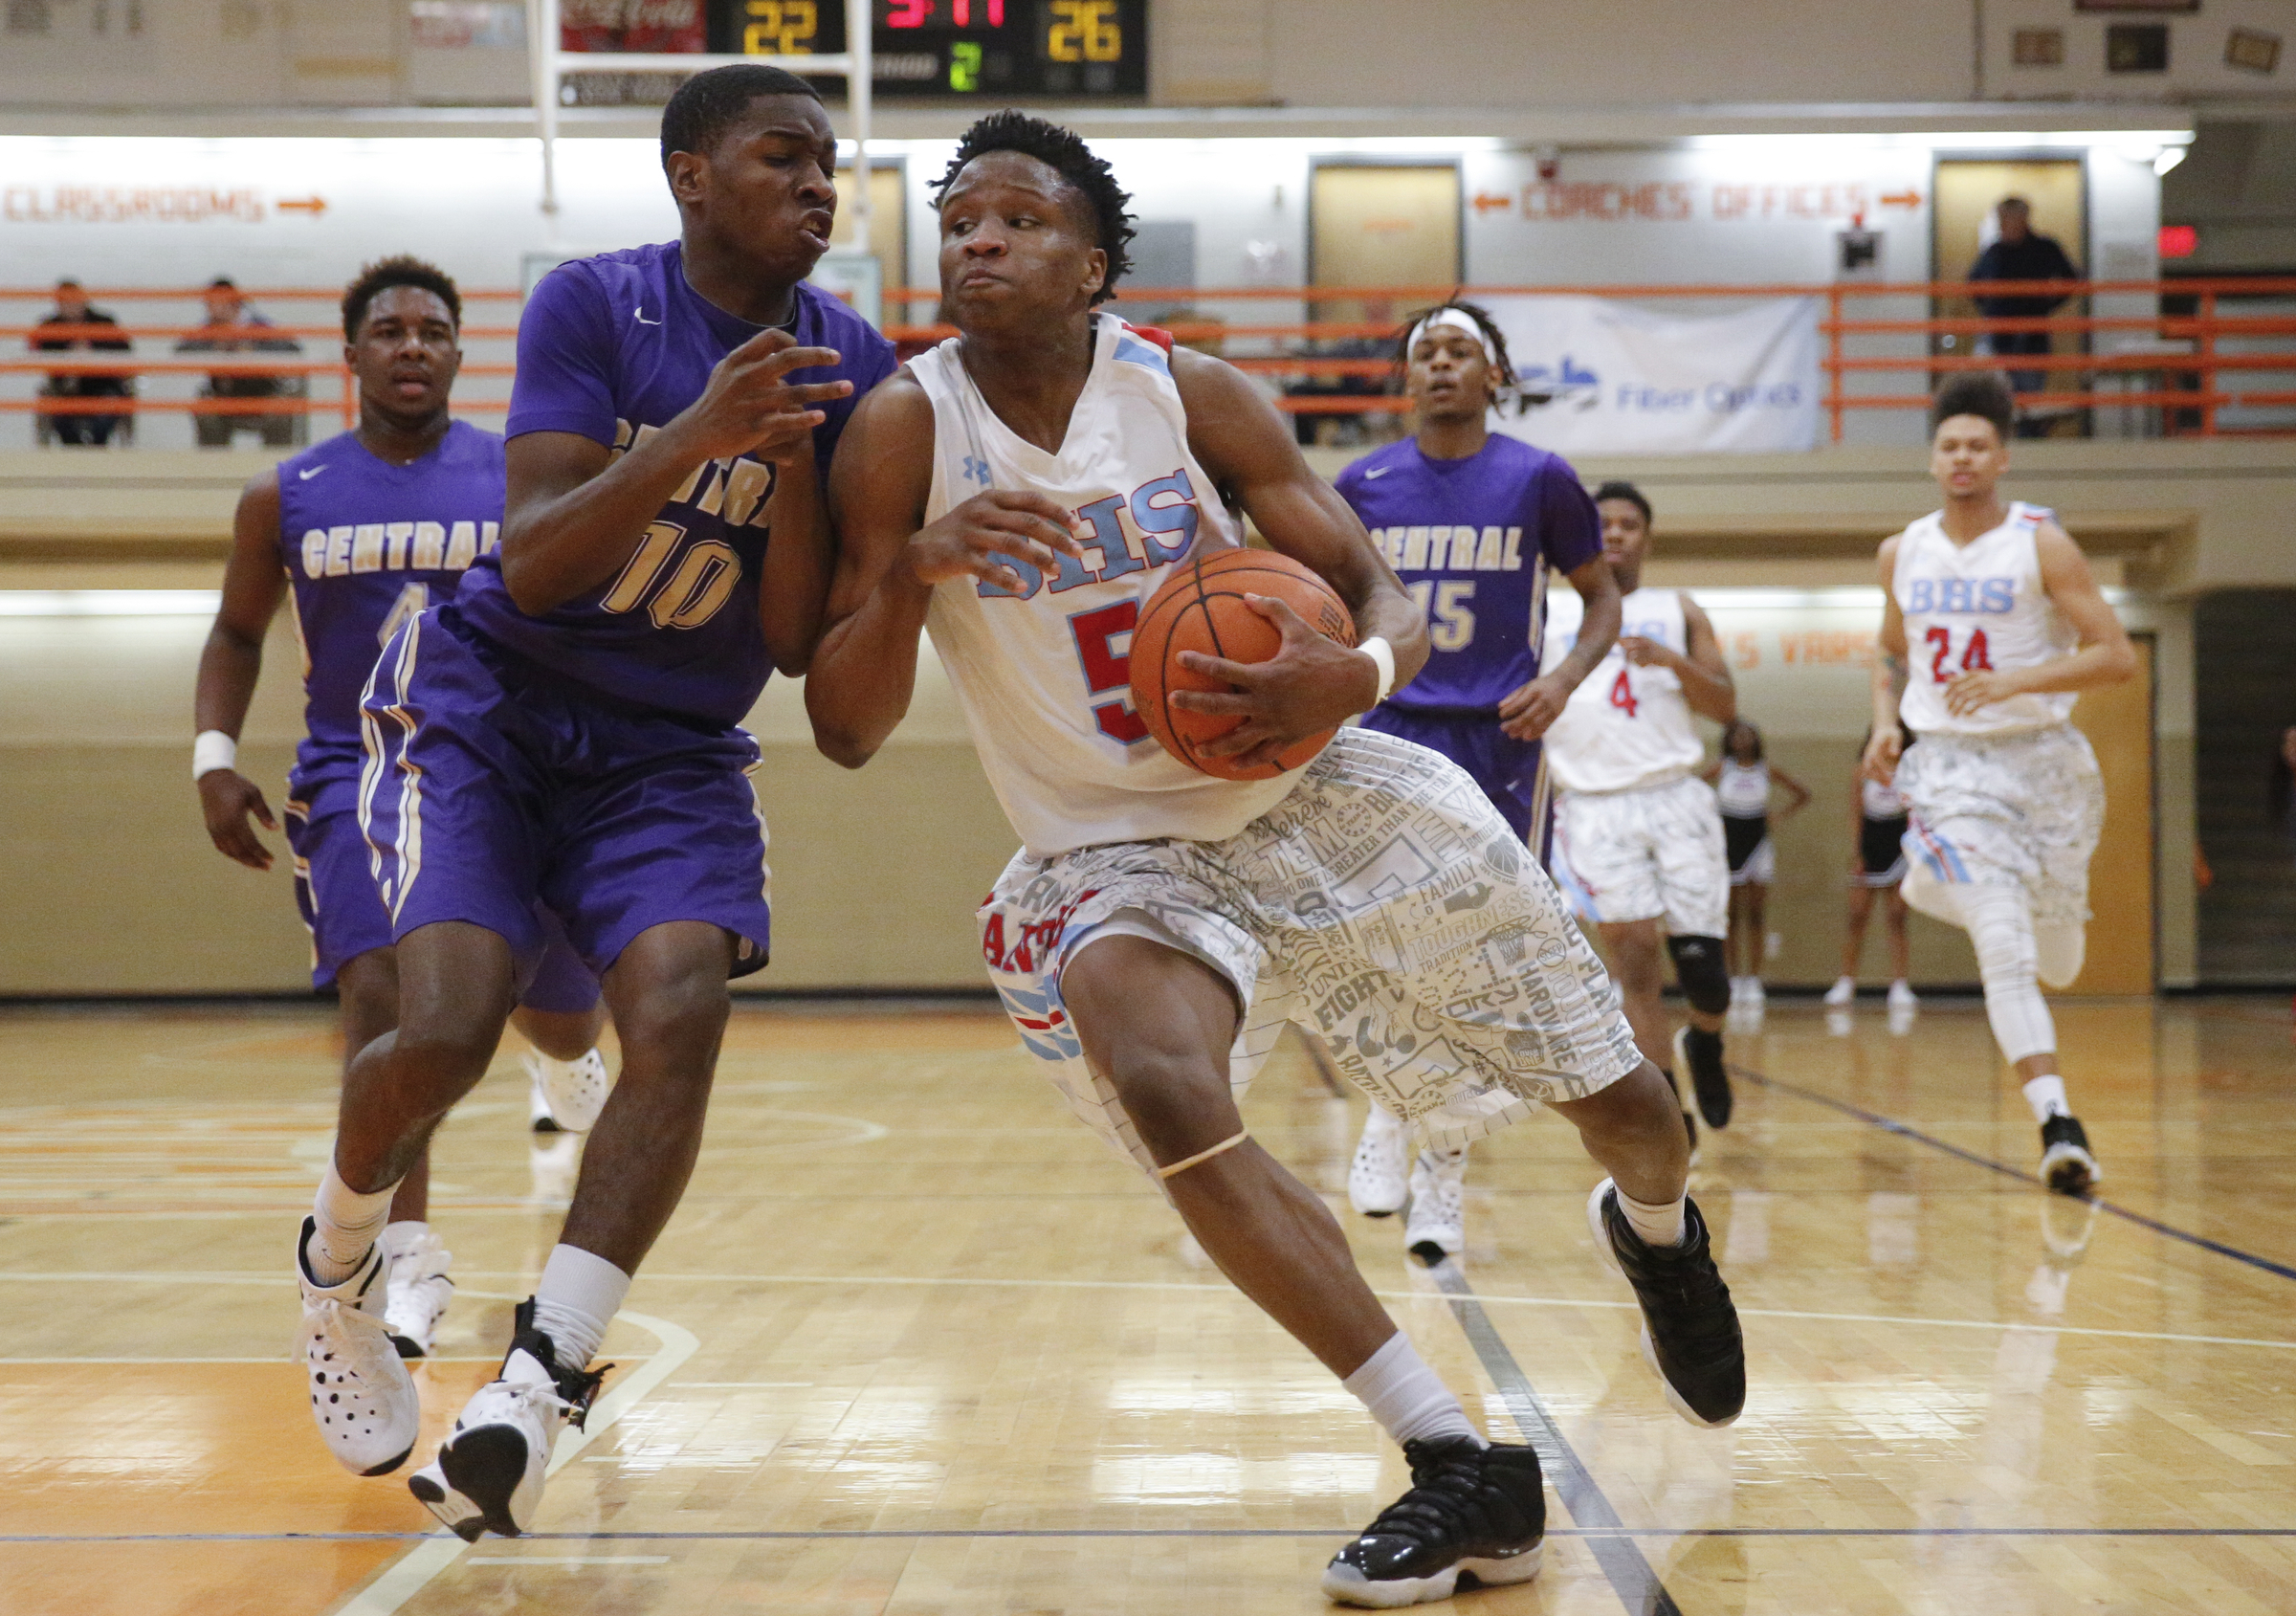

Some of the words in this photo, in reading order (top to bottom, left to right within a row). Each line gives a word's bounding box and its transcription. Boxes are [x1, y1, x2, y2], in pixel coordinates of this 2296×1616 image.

[950, 42, 982, 92] 2
[3, 185, 266, 223] CLASSROOMS
[1523, 183, 1691, 222] COACHES
[1713, 183, 1869, 221] OFFICES
[599, 520, 742, 630] 10
[1905, 577, 2014, 614] BHS
[1066, 595, 1153, 746] 5
[1926, 625, 1994, 683] 24
[1609, 669, 1638, 718] 4
[1295, 873, 1323, 891] ONE
[1377, 806, 1412, 837] THAN
[1406, 787, 1434, 812] THE
[1410, 808, 1470, 864] WIN
[1416, 856, 1478, 905] FAMILY
[1407, 884, 1535, 963] TOUGHNESS
[1419, 939, 1473, 975] TRADITION
[1314, 969, 1392, 1032] FIGHT
[1515, 960, 1578, 1071] HARDWARE
